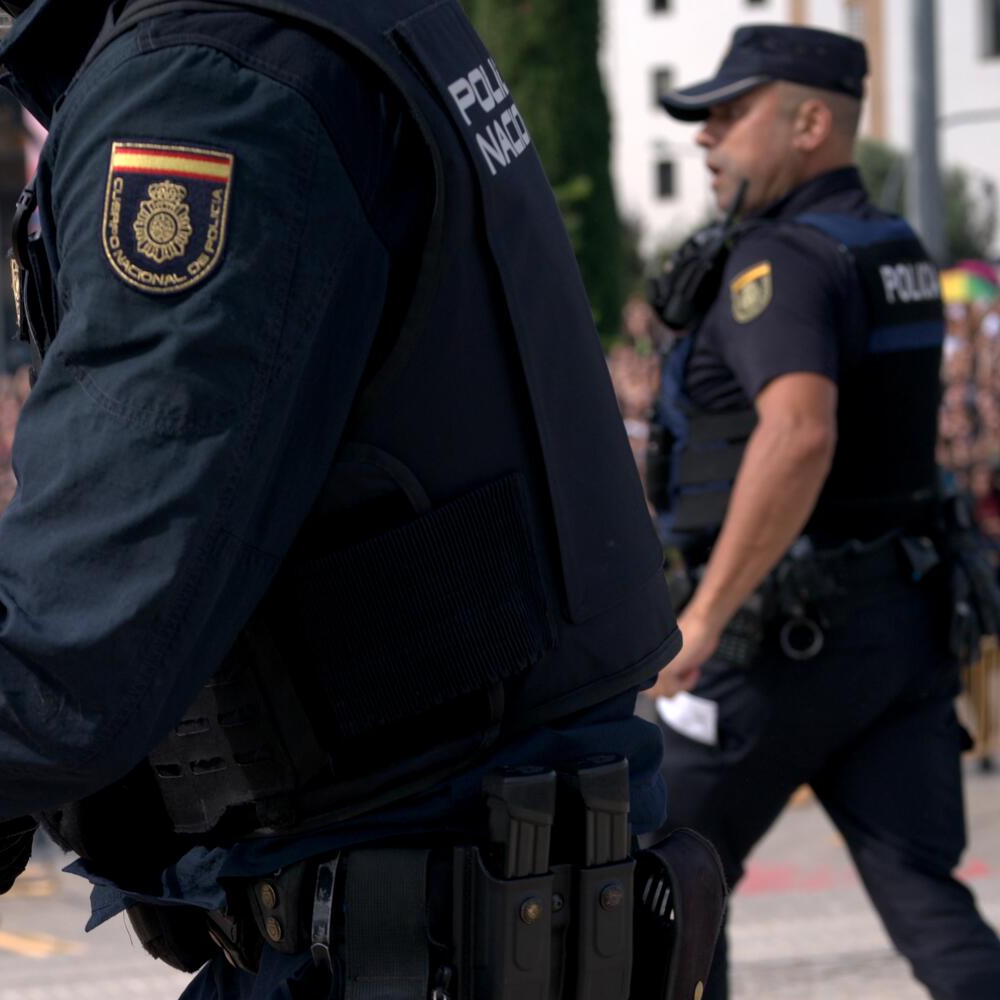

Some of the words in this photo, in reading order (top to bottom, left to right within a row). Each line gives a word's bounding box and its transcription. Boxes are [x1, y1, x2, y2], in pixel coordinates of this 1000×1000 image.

[114, 249, 187, 285] NACIONAL
[187, 254, 210, 275] DE
[205, 188, 223, 253] POLICIA
